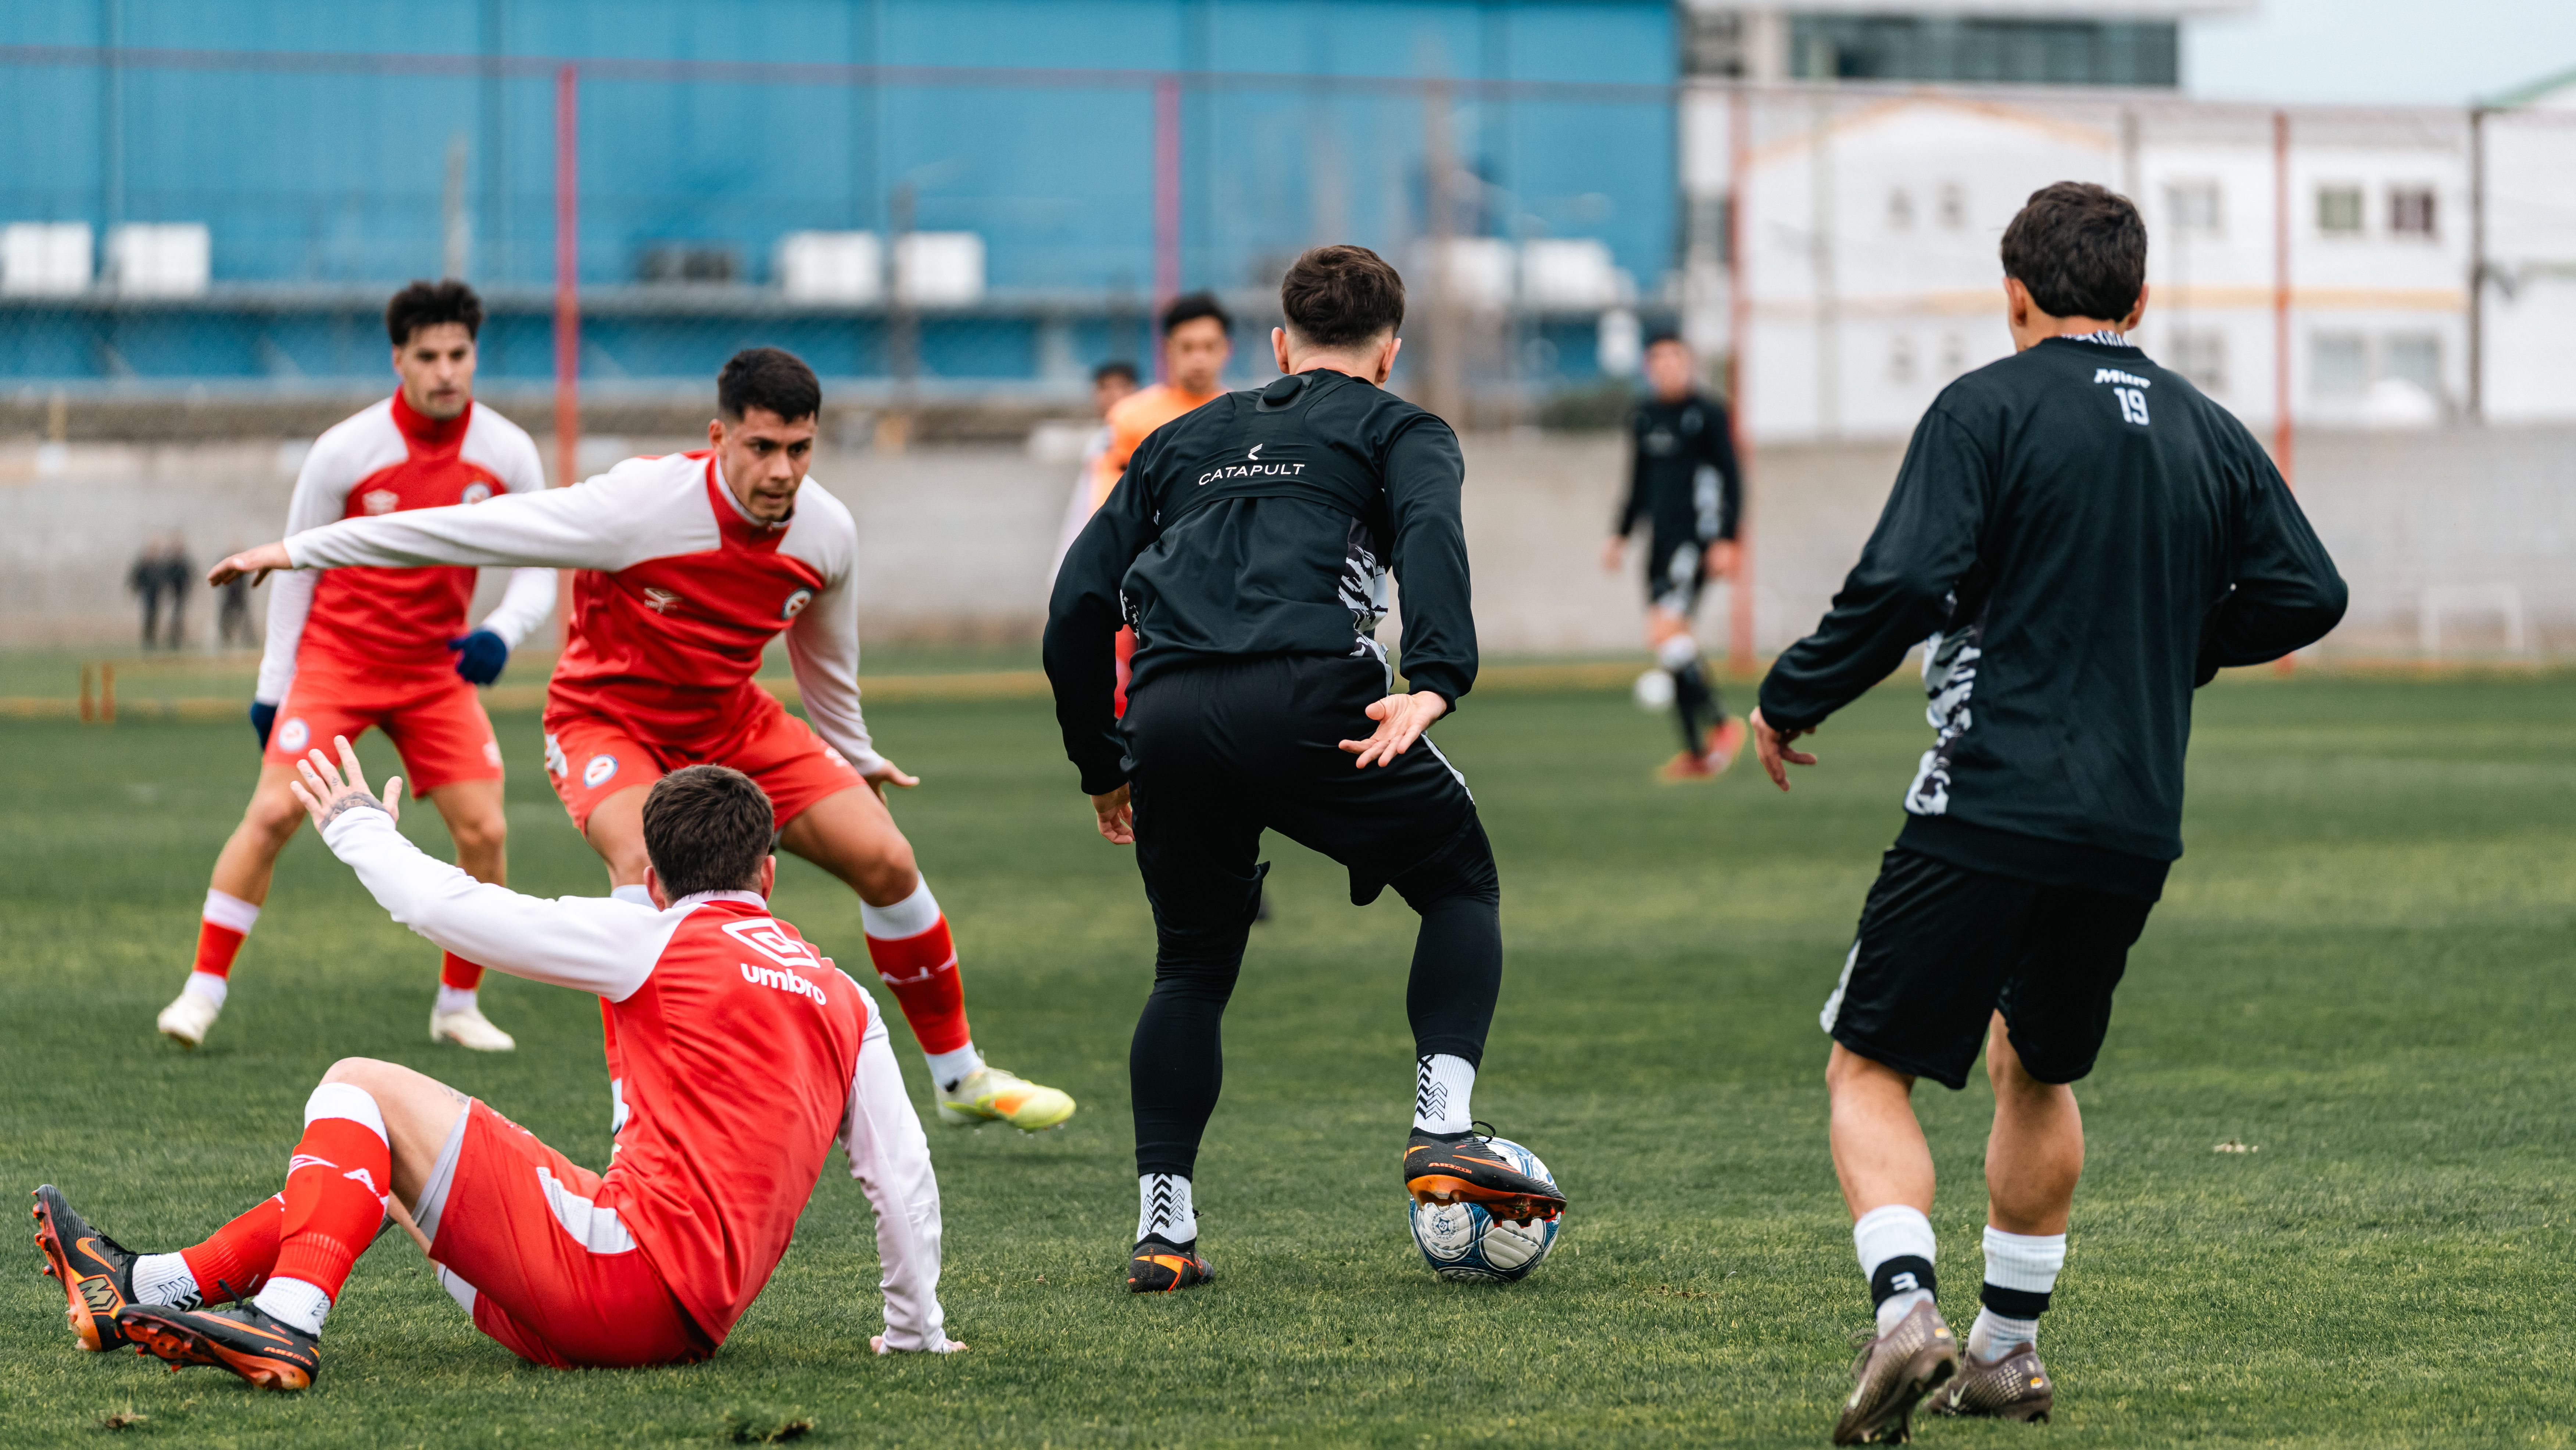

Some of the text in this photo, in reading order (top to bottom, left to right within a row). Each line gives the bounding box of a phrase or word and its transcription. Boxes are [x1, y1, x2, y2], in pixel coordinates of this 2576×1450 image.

[2114, 387, 2150, 426] 19
[1198, 464, 1305, 485] CATAPULT
[740, 963, 827, 1006] umbro
